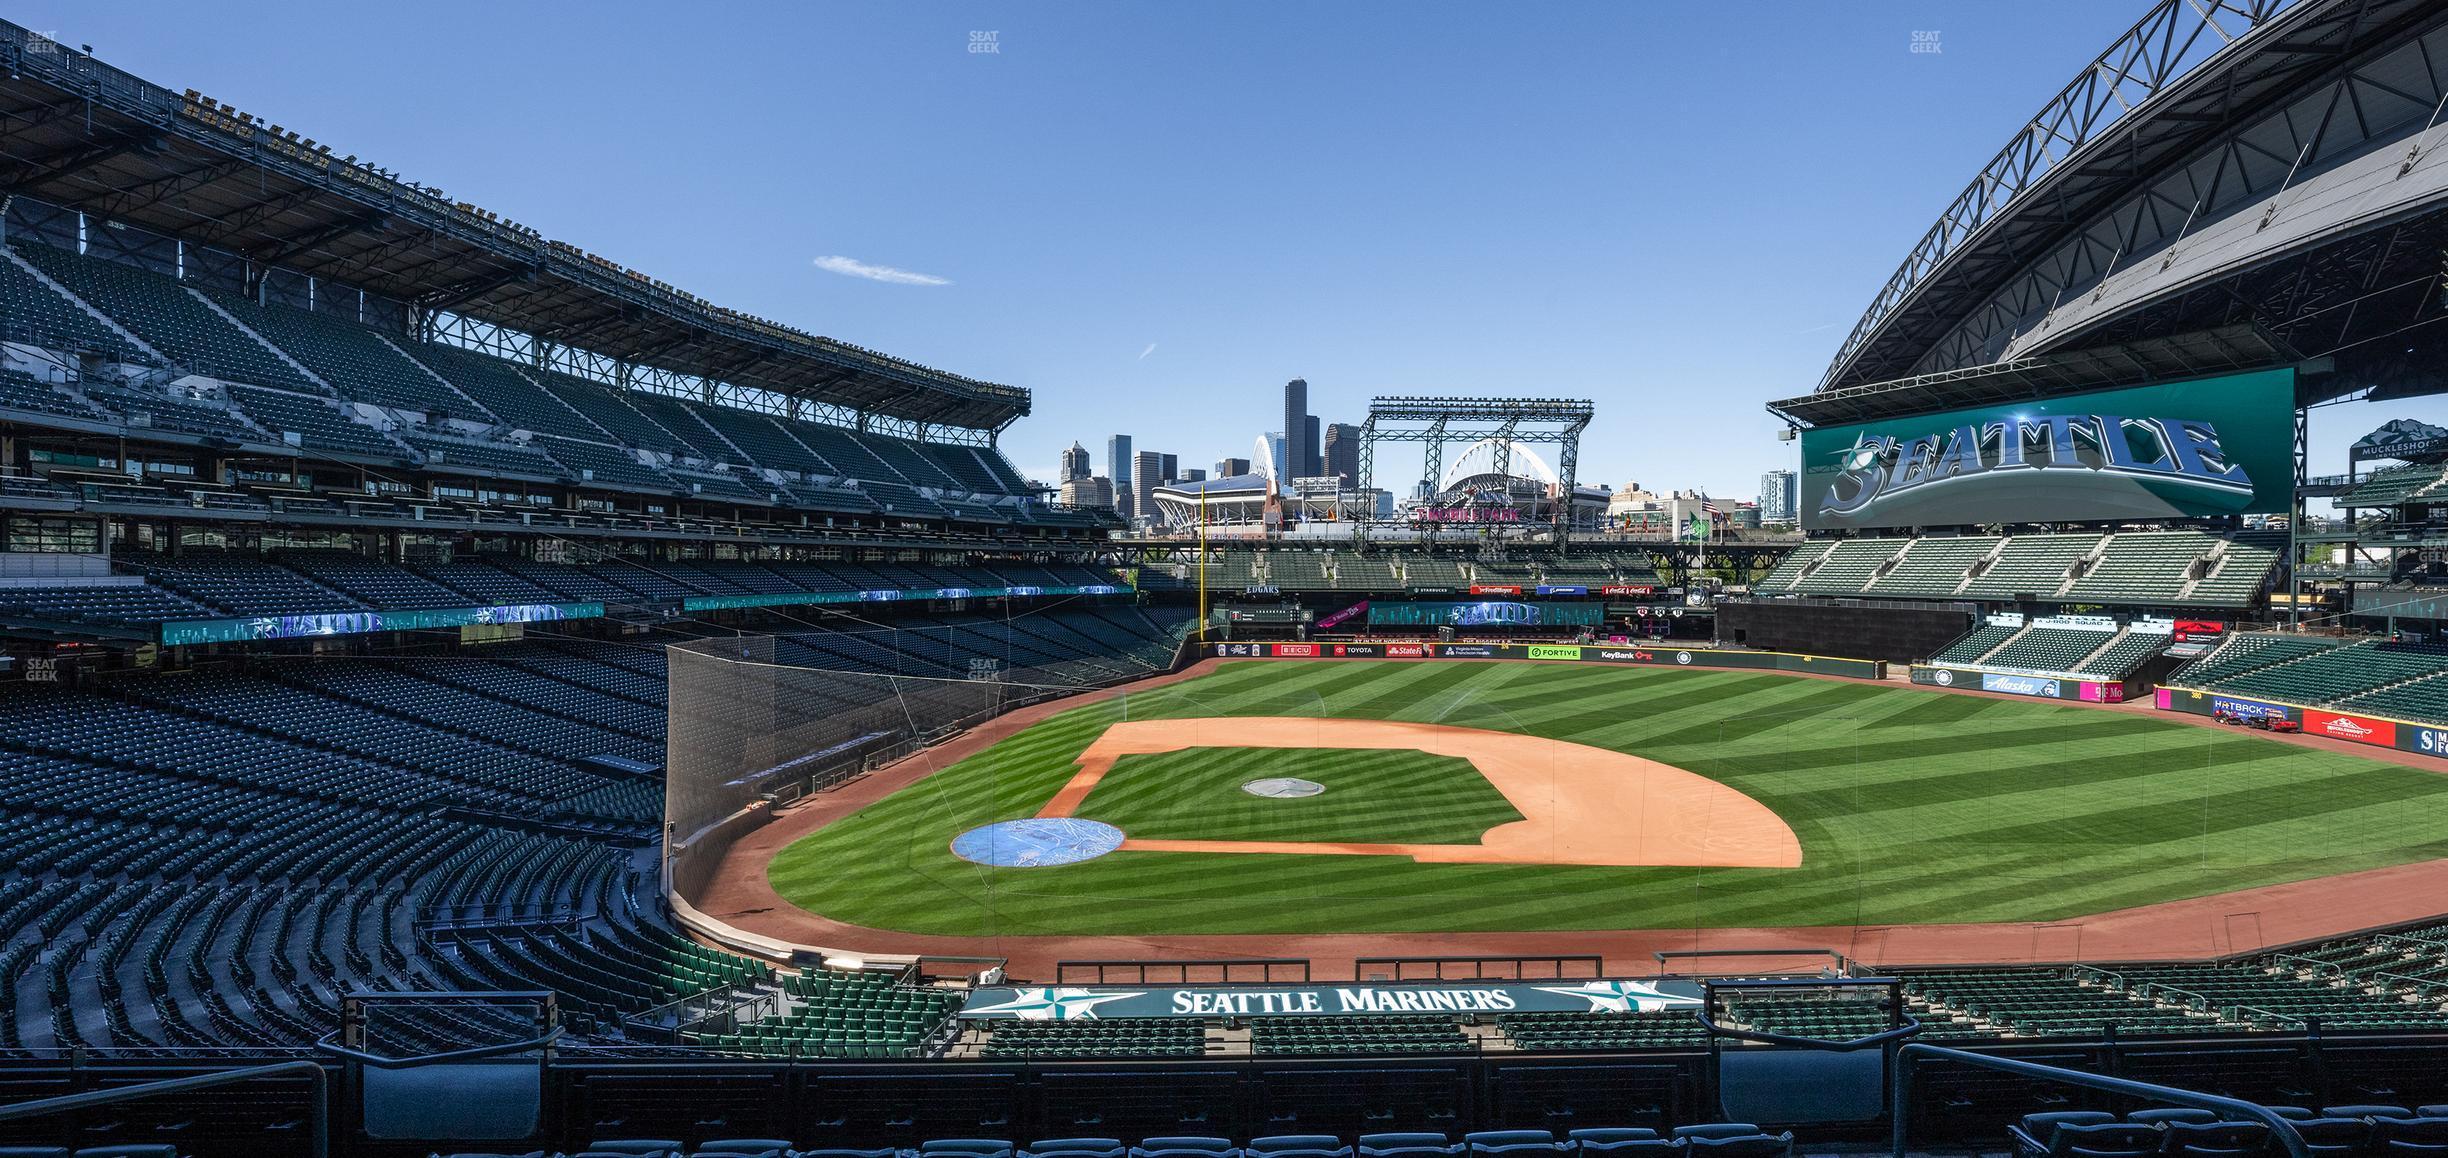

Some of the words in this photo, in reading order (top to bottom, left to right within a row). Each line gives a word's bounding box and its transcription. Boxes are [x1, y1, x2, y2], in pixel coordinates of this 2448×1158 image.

[1818, 414, 2254, 516] SEATTLE
[1482, 508, 1520, 522] PARK
[1602, 651, 1634, 659] KeyBank
[1986, 677, 2034, 692] Alaska
[1172, 989, 1322, 1014] SEATTLE
[1338, 987, 1516, 1013] MARINERS
